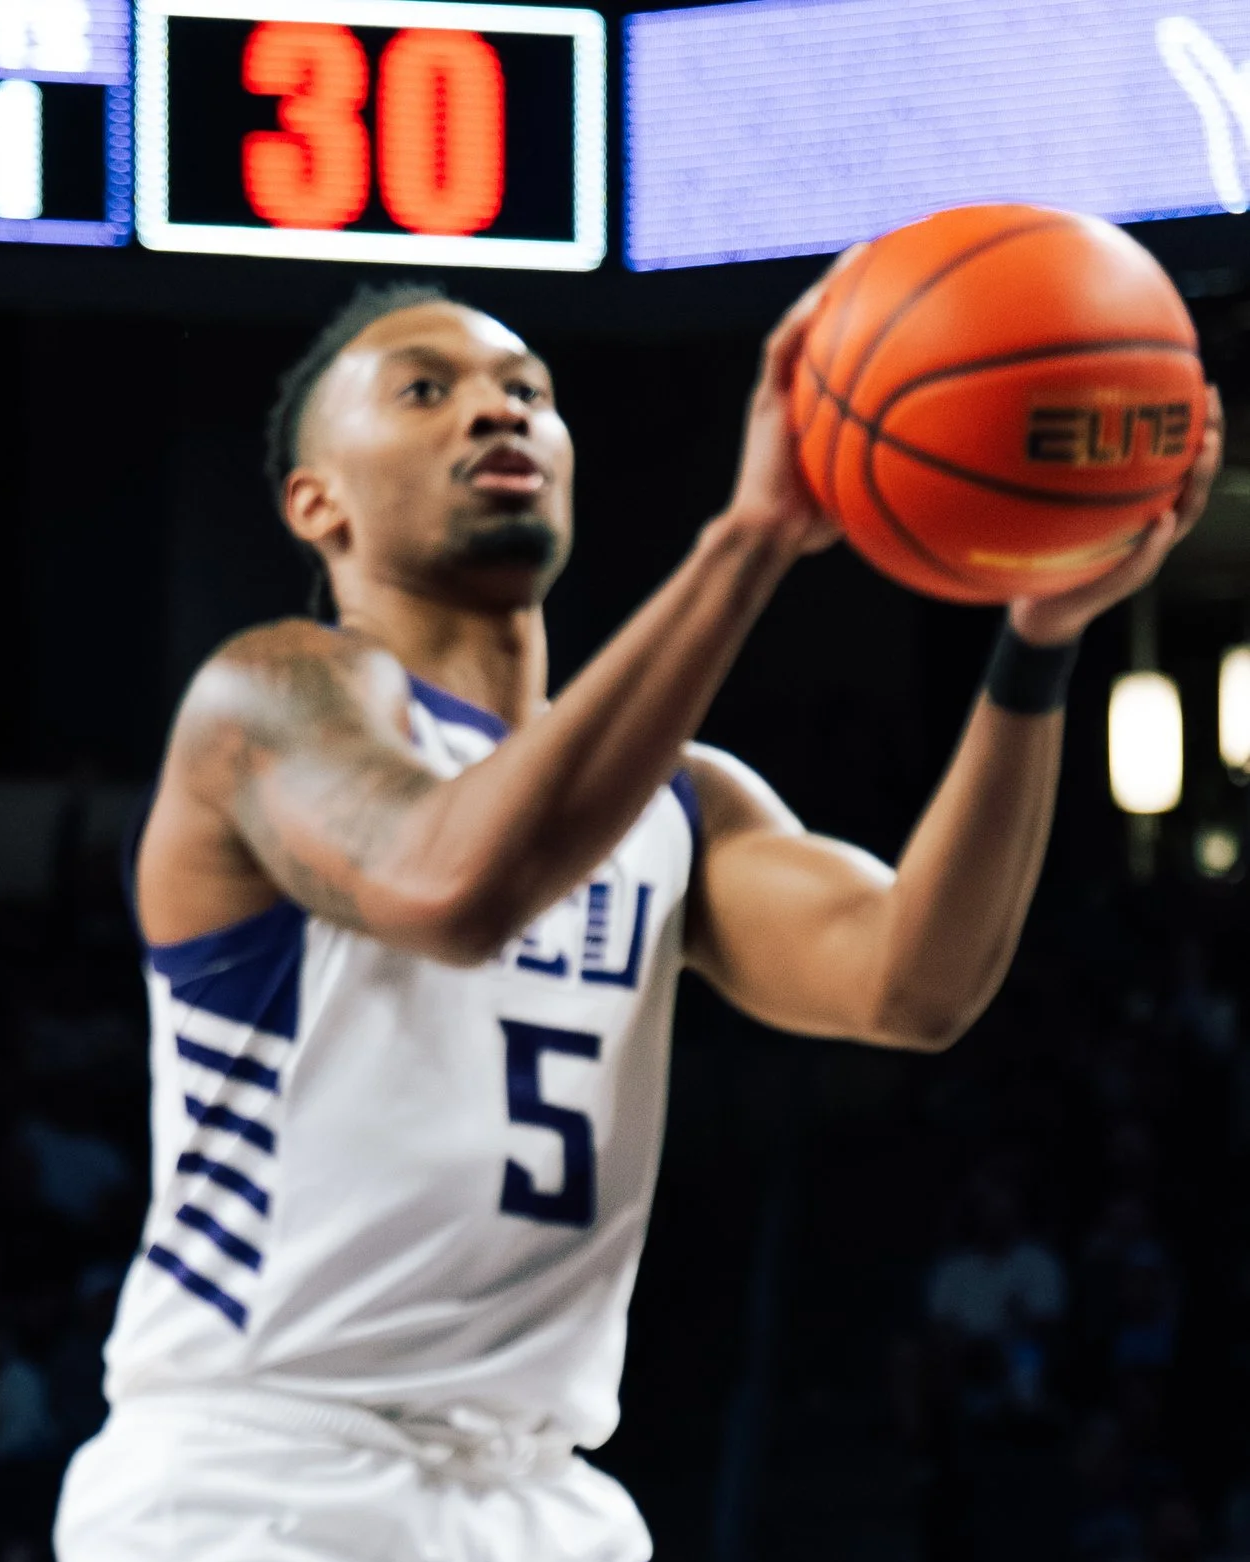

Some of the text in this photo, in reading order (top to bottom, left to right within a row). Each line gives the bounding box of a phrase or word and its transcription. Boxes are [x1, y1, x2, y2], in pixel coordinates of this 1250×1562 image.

[242, 20, 506, 236] 30
[1027, 402, 1192, 463] ELITE
[499, 1018, 602, 1229] 5
